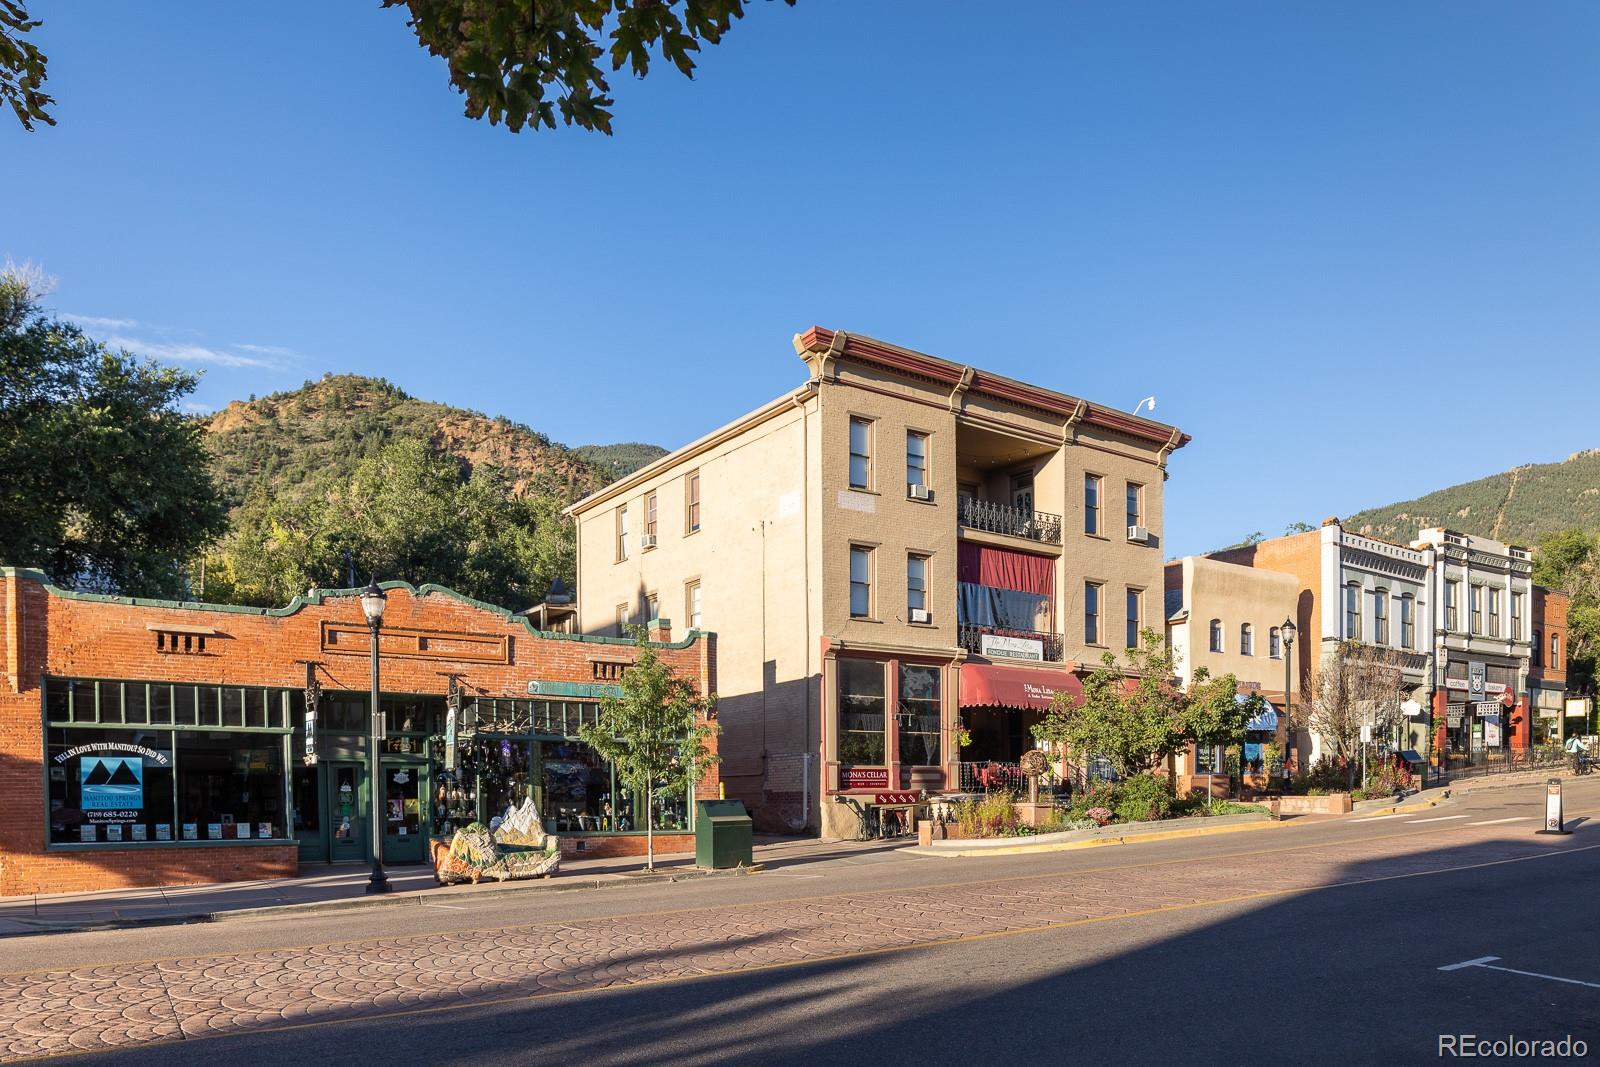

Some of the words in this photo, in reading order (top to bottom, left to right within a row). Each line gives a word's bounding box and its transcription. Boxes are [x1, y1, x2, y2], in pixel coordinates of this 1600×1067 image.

[1009, 651, 1039, 659] RESTAURANT
[54, 751, 70, 764] FELL
[68, 748, 77, 758] IN
[75, 743, 92, 755] LOVE
[91, 742, 108, 751] WITH
[108, 742, 138, 752] MANITOU?
[137, 745, 146, 755] SO
[145, 748, 157, 758] DID
